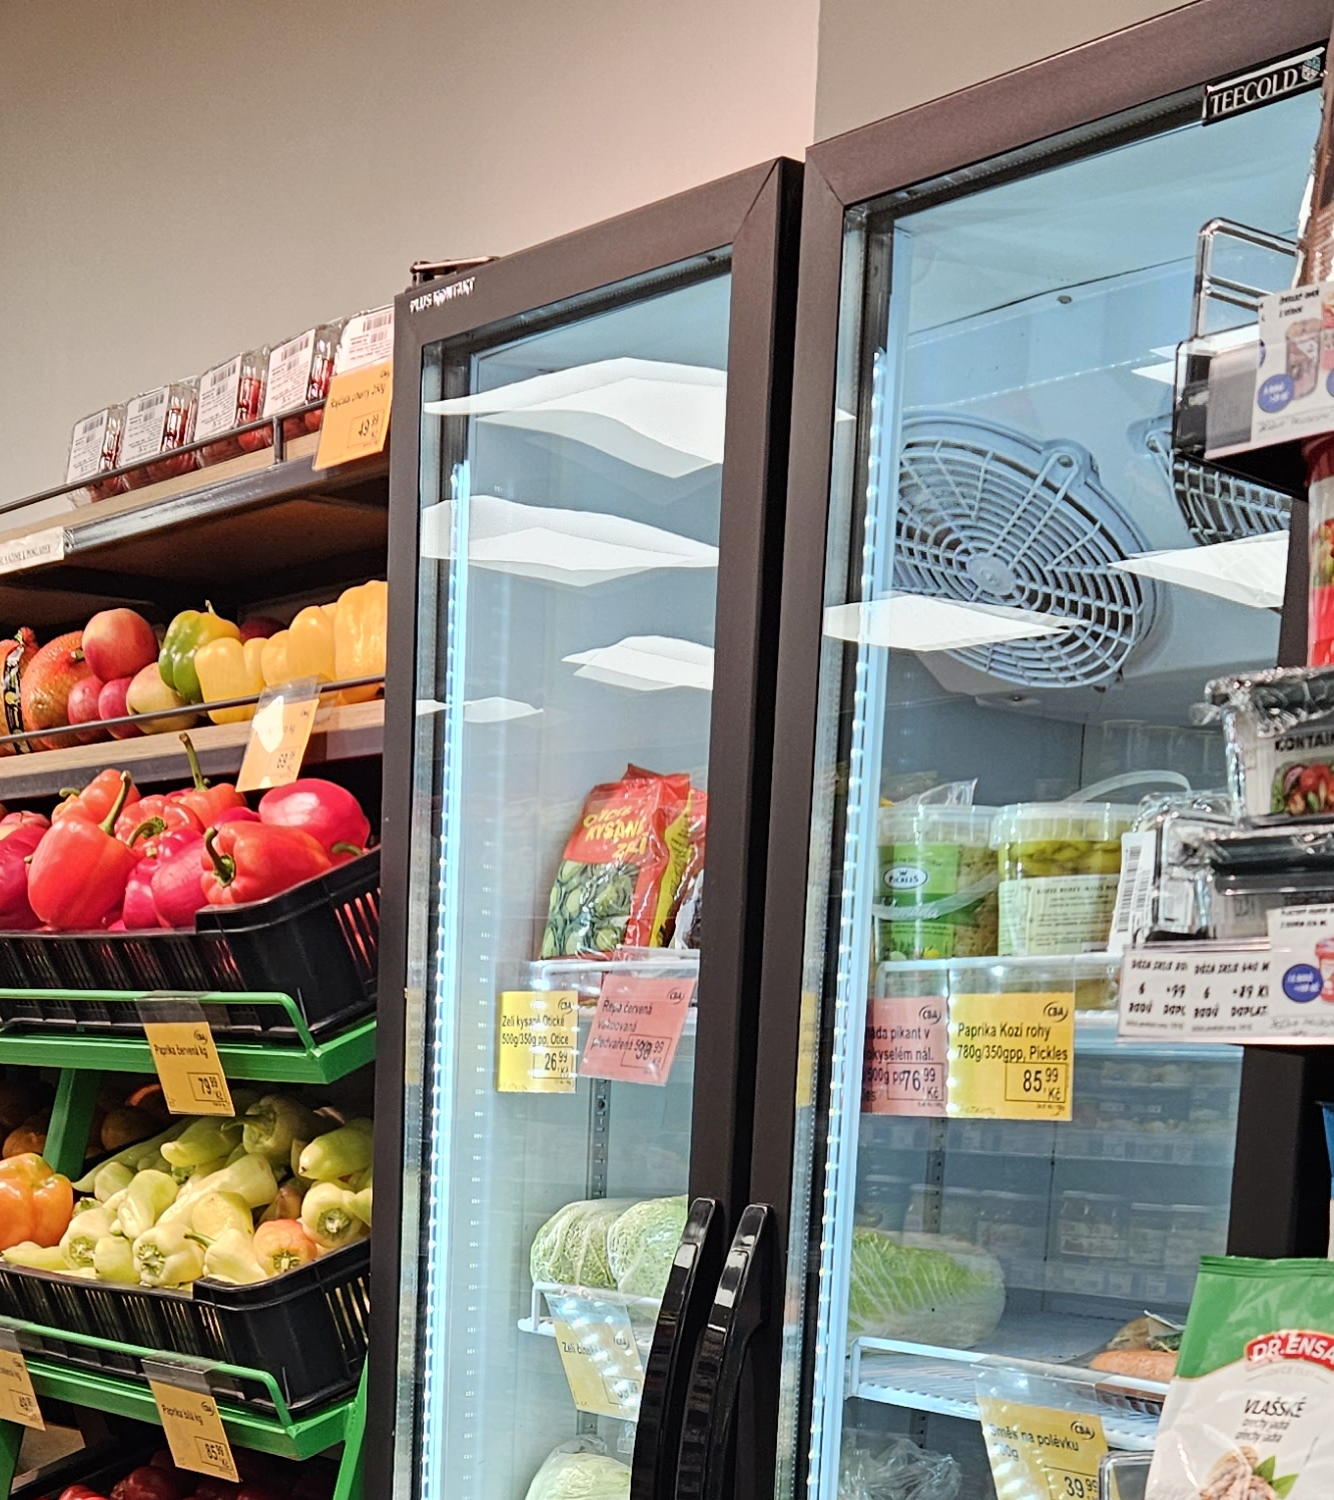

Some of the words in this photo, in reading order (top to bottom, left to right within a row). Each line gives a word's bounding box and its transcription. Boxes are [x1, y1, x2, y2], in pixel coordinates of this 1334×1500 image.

[1208, 64, 1300, 117] TEECOLD
[890, 1026, 922, 1041] pikant
[957, 1022, 998, 1040] Paprika
[999, 1021, 1023, 1037] Kozí
[1026, 1024, 1052, 1042] rohy
[1028, 1044, 1069, 1062] Pickles
[1036, 1433, 1080, 1453] polévku
